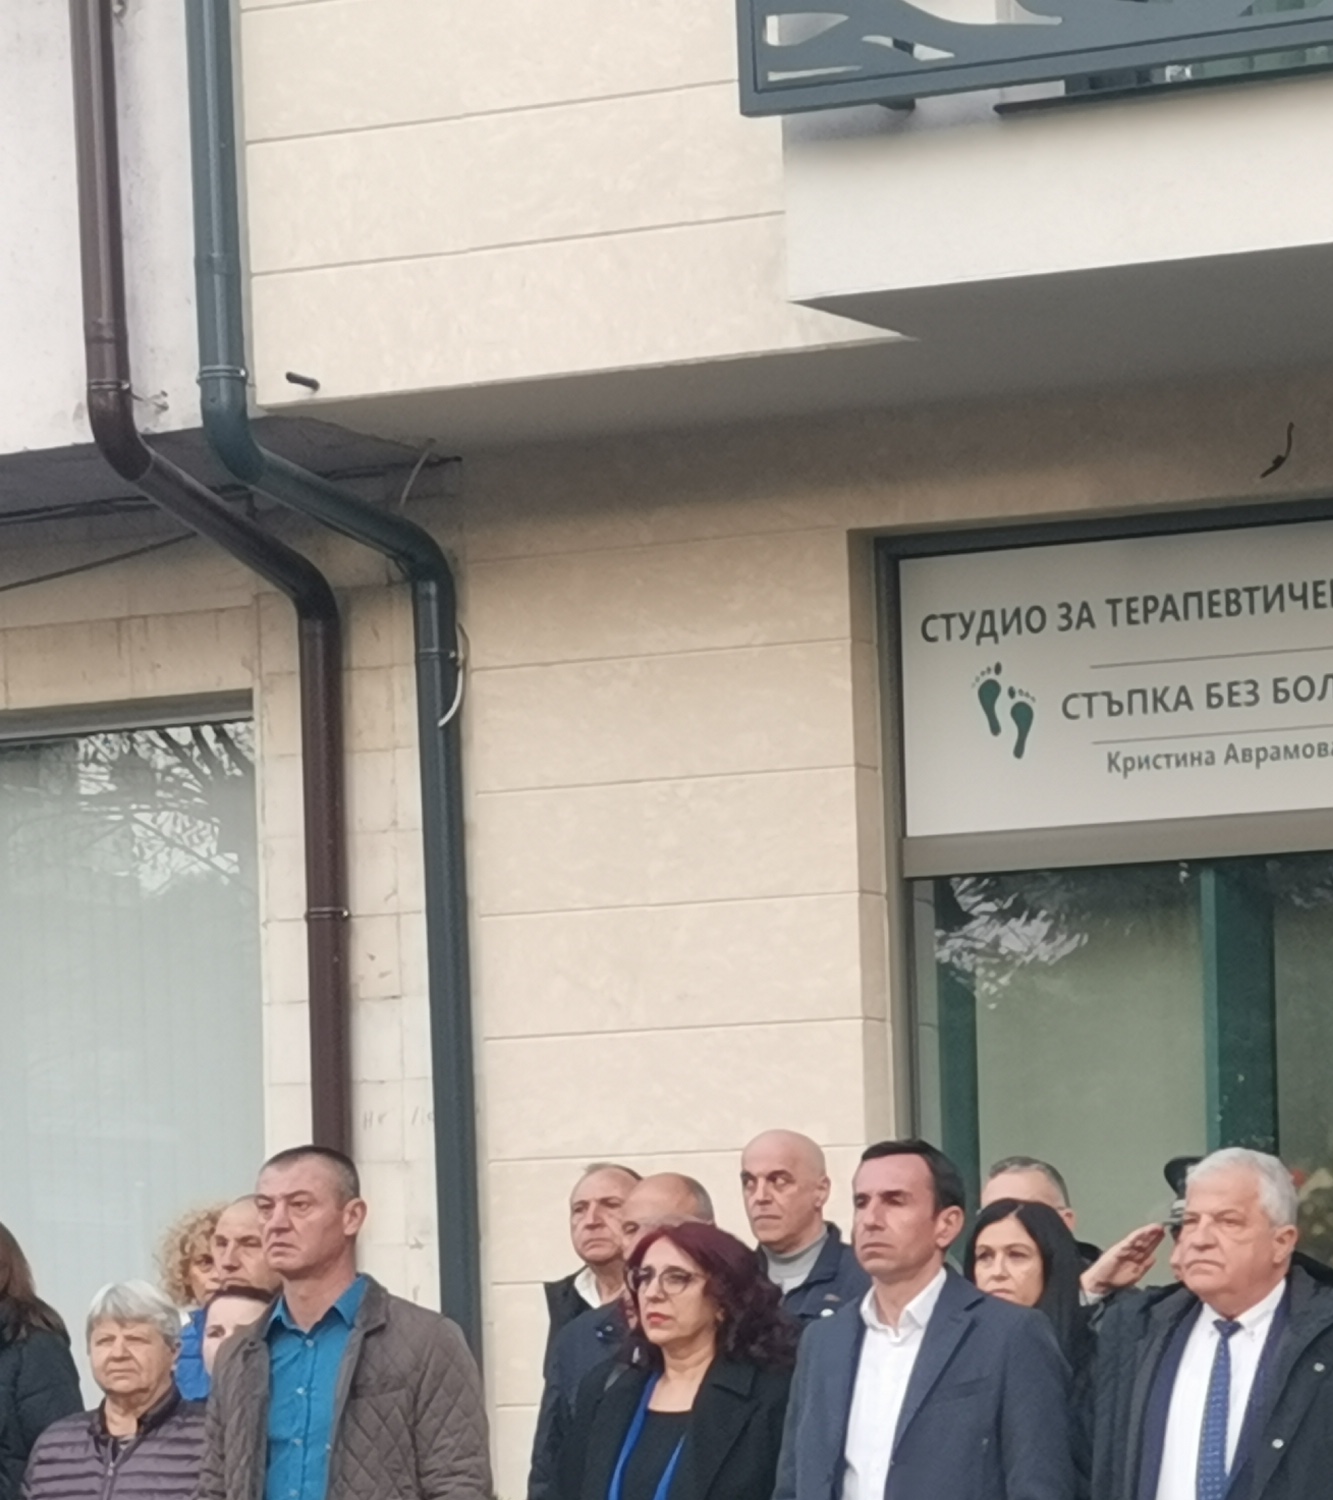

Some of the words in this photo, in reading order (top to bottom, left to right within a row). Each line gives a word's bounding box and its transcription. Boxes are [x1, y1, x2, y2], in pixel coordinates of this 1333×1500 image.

[921, 605, 1047, 647] СТУДИО
[1056, 601, 1097, 632] ЗА
[1061, 685, 1195, 721] СТЪПКА
[1205, 678, 1261, 710] БЕЗ
[1106, 748, 1217, 780] Кристина
